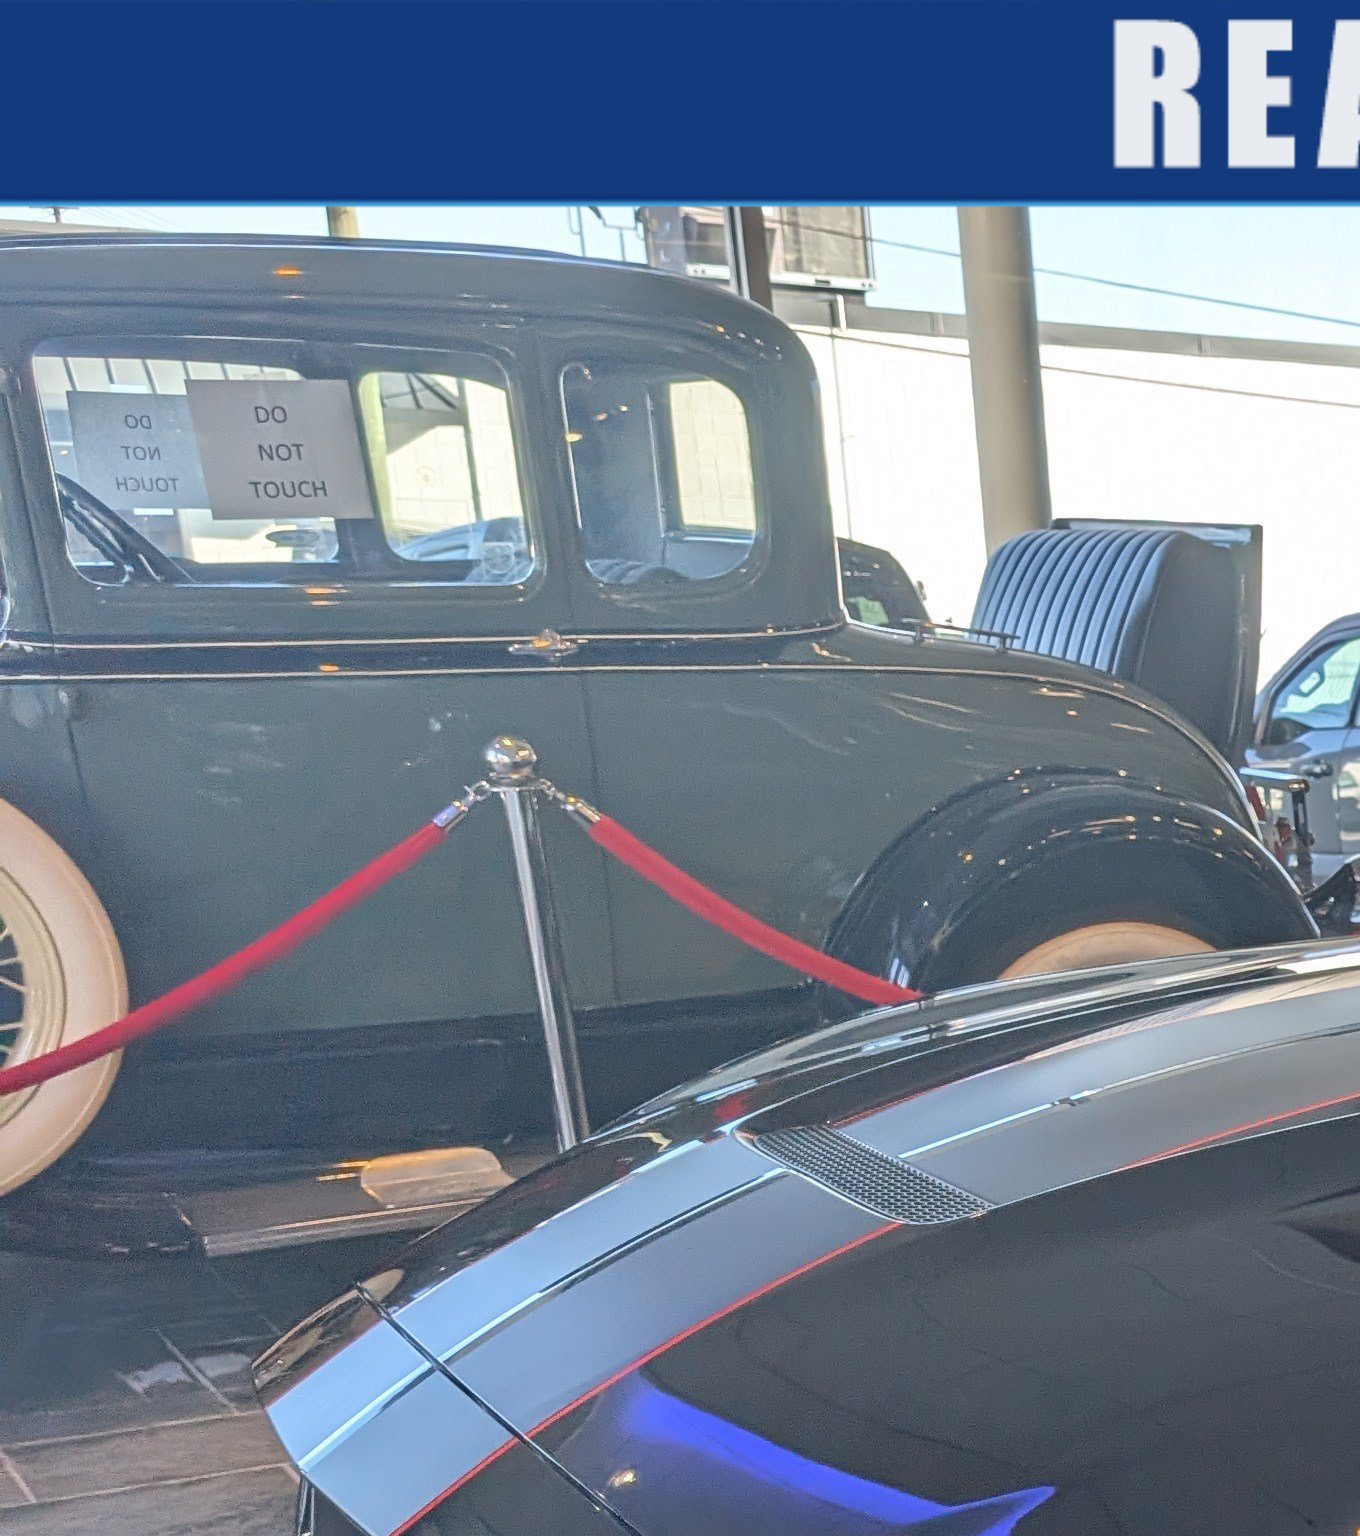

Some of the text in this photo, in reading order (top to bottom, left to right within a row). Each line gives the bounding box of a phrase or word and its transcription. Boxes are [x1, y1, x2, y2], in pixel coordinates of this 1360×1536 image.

[254, 405, 287, 424] DO
[258, 444, 303, 461] NOT
[249, 480, 328, 499] TOUCH
